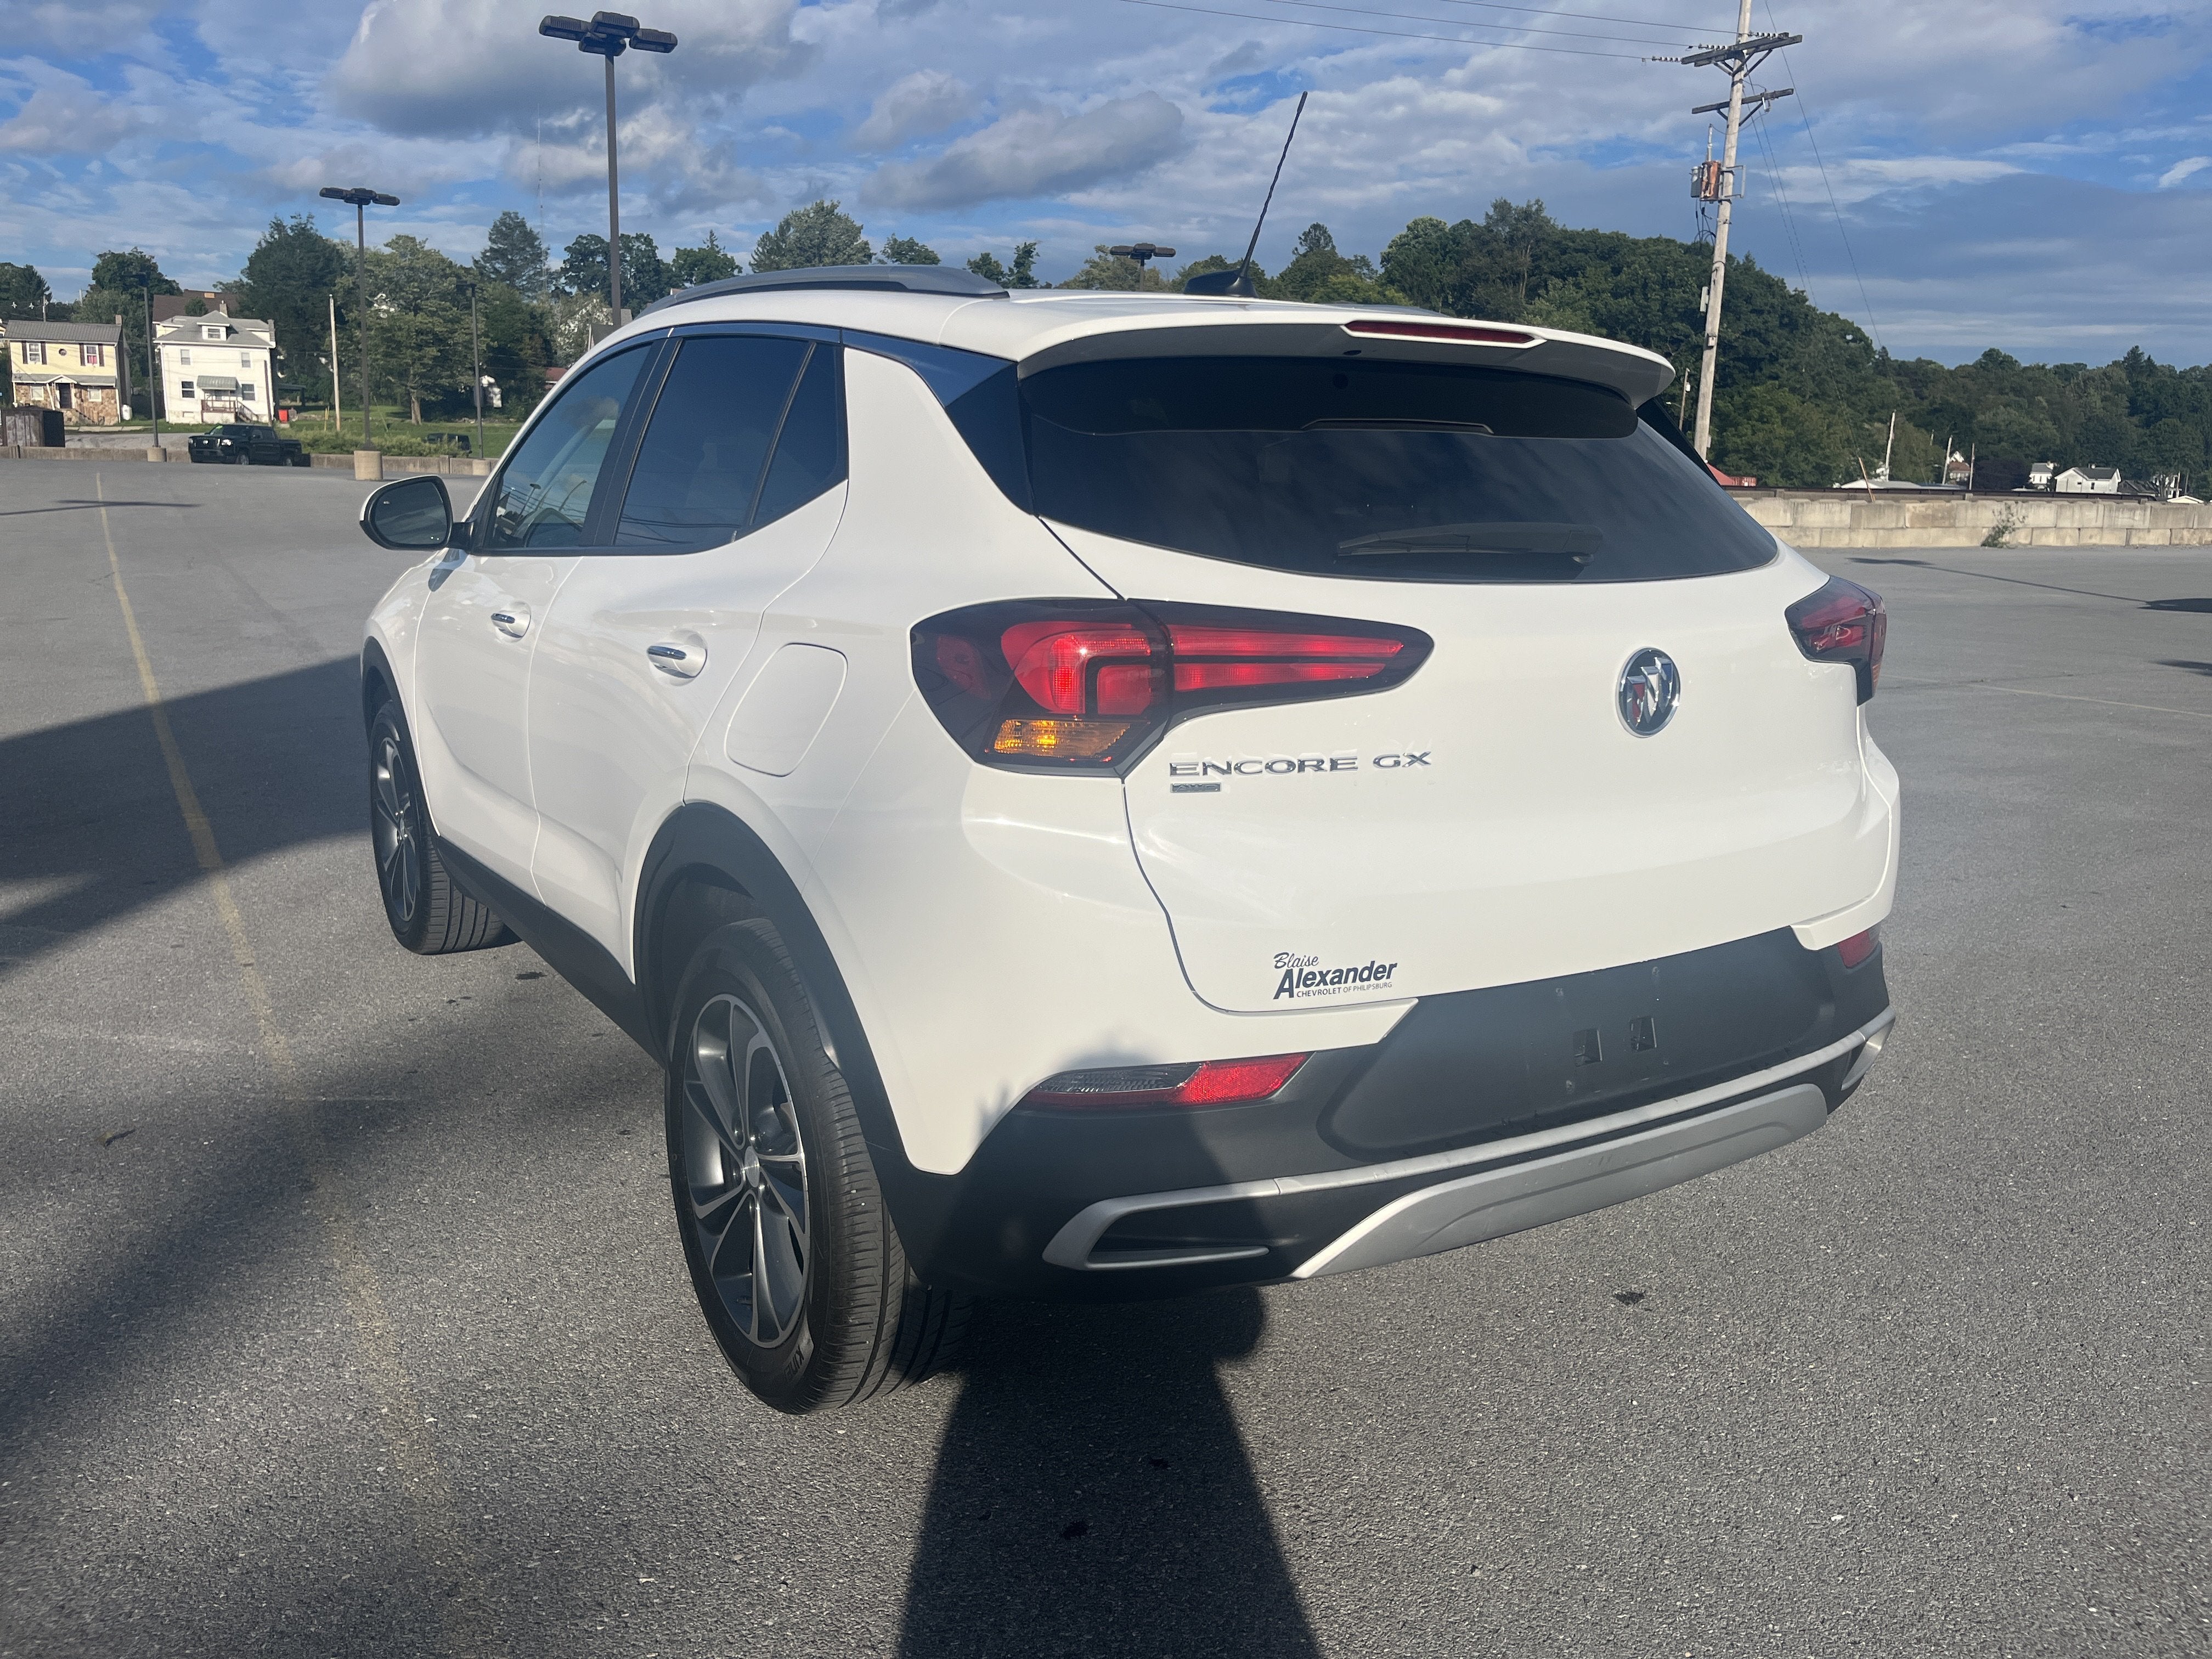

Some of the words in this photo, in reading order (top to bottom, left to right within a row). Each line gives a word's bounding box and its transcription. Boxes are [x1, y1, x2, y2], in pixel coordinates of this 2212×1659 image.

[1169, 755, 1358, 777] ENCORE
[1373, 751, 1432, 769] GX
[1273, 952, 1319, 969] Blaise
[1273, 961, 1398, 1000] Alexander
[1296, 987, 1342, 997] CHEVROLET
